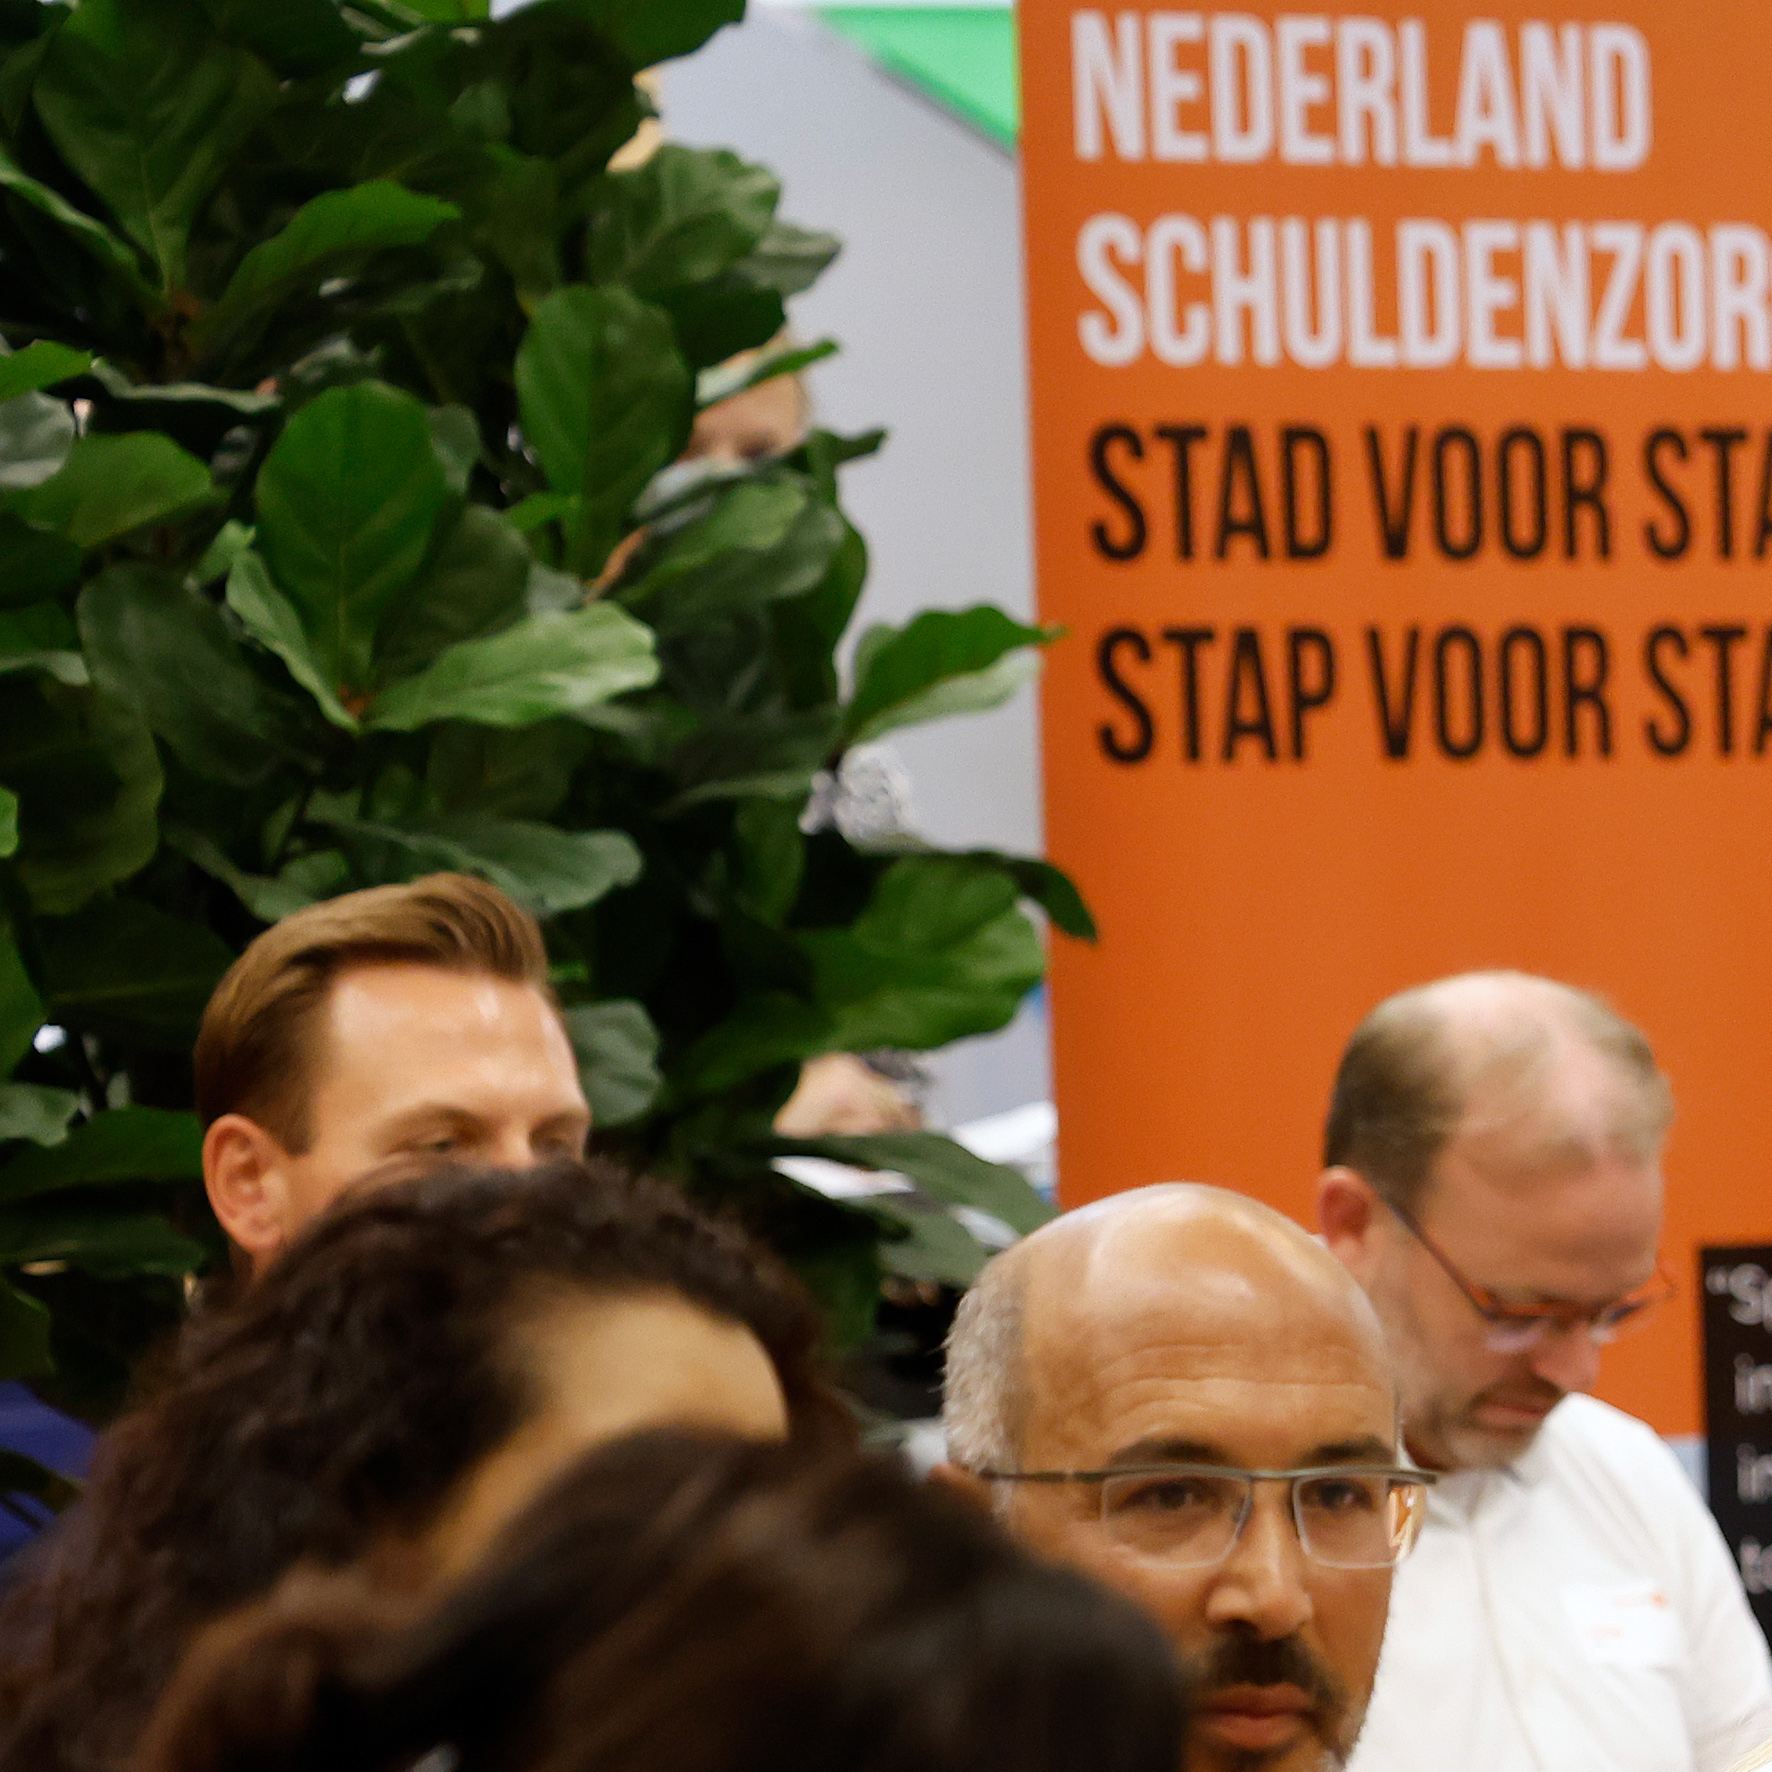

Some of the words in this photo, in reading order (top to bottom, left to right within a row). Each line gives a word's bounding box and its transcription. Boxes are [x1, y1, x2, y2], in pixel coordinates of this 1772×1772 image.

[1070, 9, 1652, 169] NEDERLAND
[1087, 420, 1334, 564] STAD
[1364, 422, 1612, 564] VOOR
[1094, 623, 1338, 764] STAP
[1366, 622, 1613, 762] VOOR
